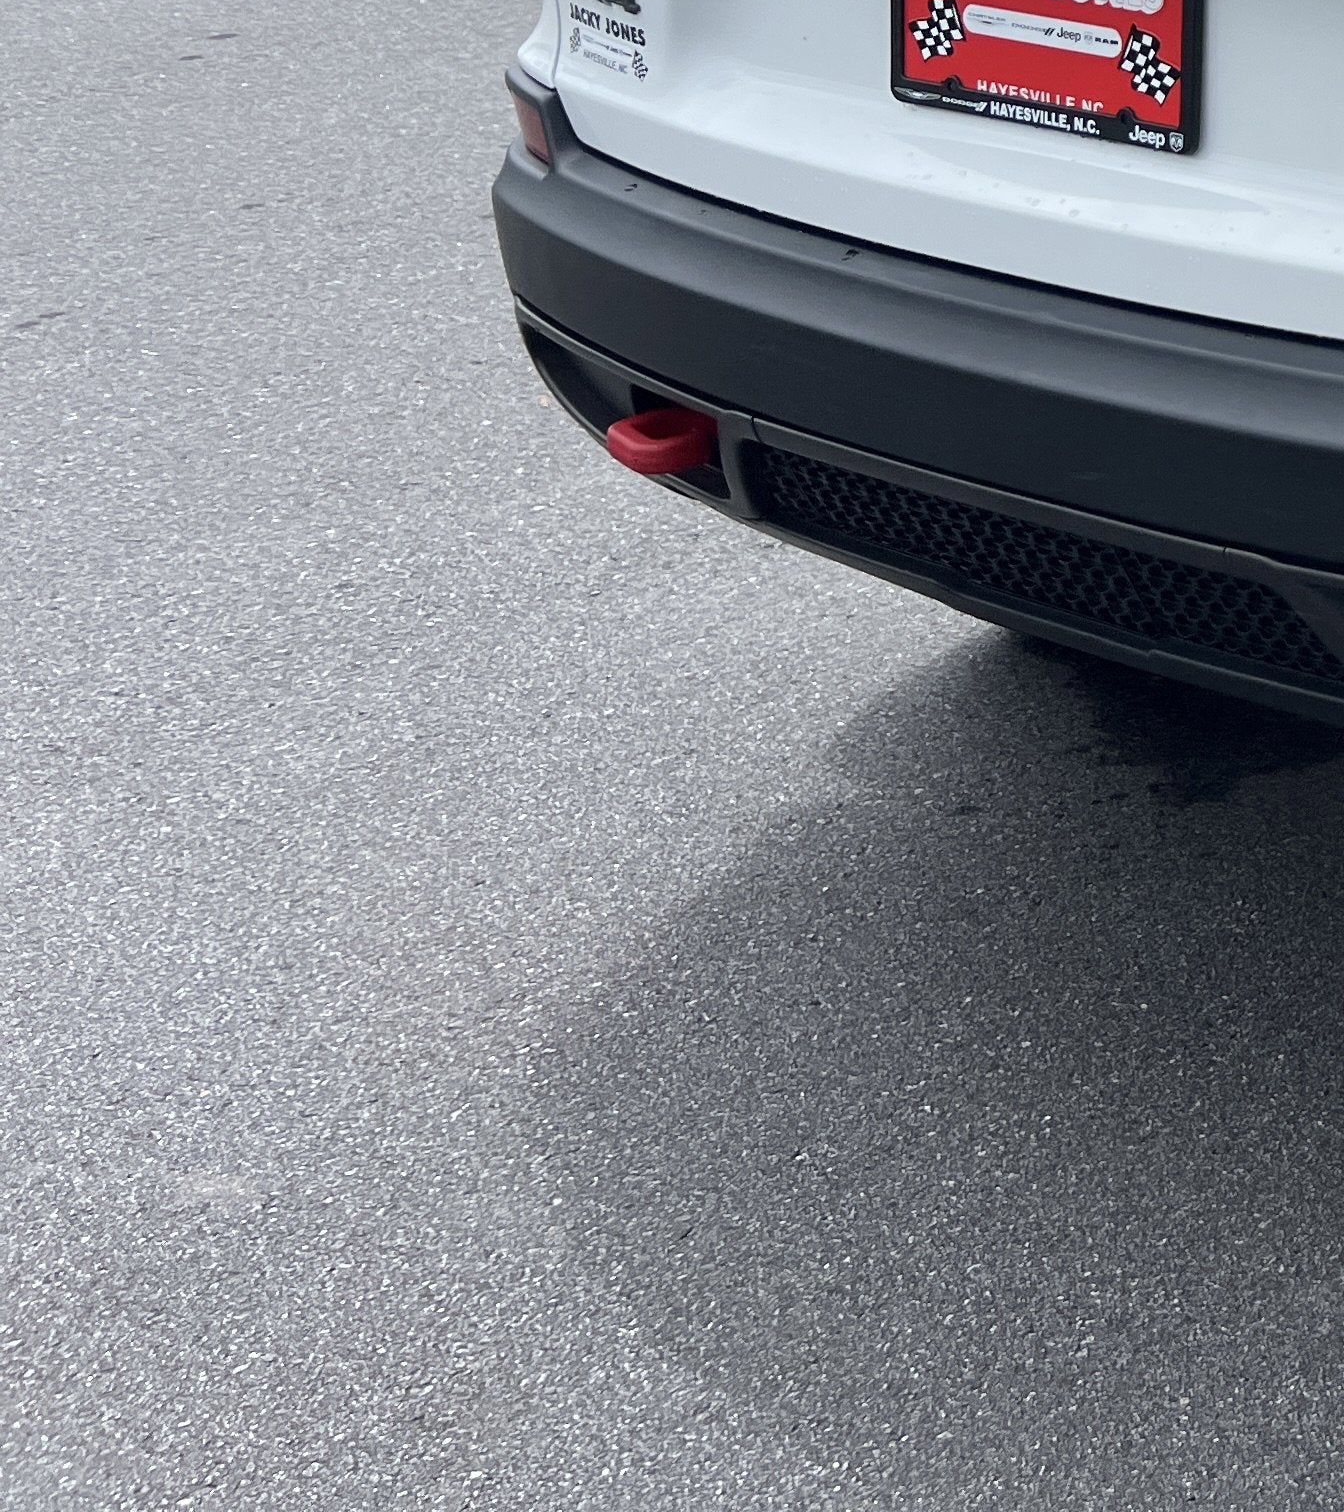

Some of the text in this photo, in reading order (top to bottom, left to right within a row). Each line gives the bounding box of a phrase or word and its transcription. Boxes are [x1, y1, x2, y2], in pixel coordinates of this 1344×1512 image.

[569, 1, 601, 31] JACKY
[605, 17, 646, 46] JONES
[1056, 27, 1082, 43] Jeep
[990, 101, 1100, 135] HAYESVILLE, N.C.
[1129, 125, 1166, 149] Jeep
